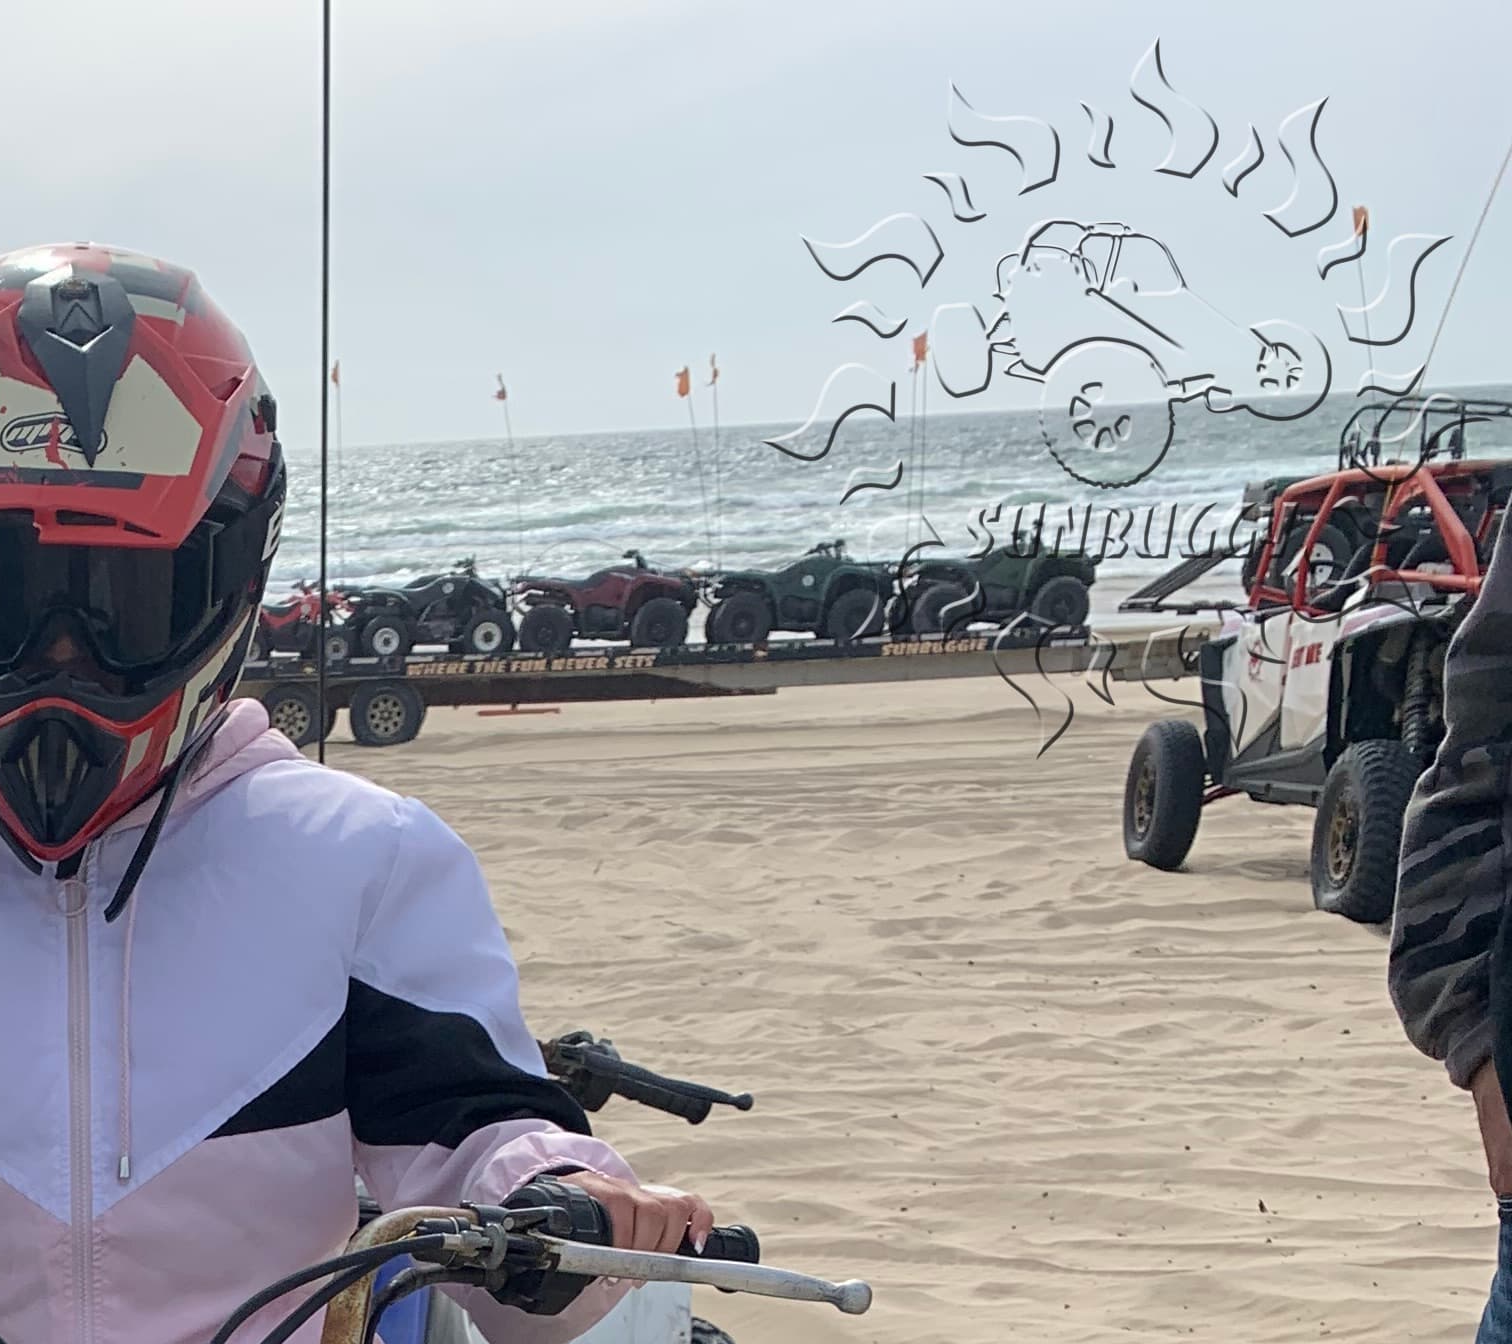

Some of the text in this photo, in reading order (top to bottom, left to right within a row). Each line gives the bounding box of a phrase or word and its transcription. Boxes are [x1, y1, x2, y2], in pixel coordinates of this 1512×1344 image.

[406, 655, 657, 675] WHERE THE FUN NEVER SETS
